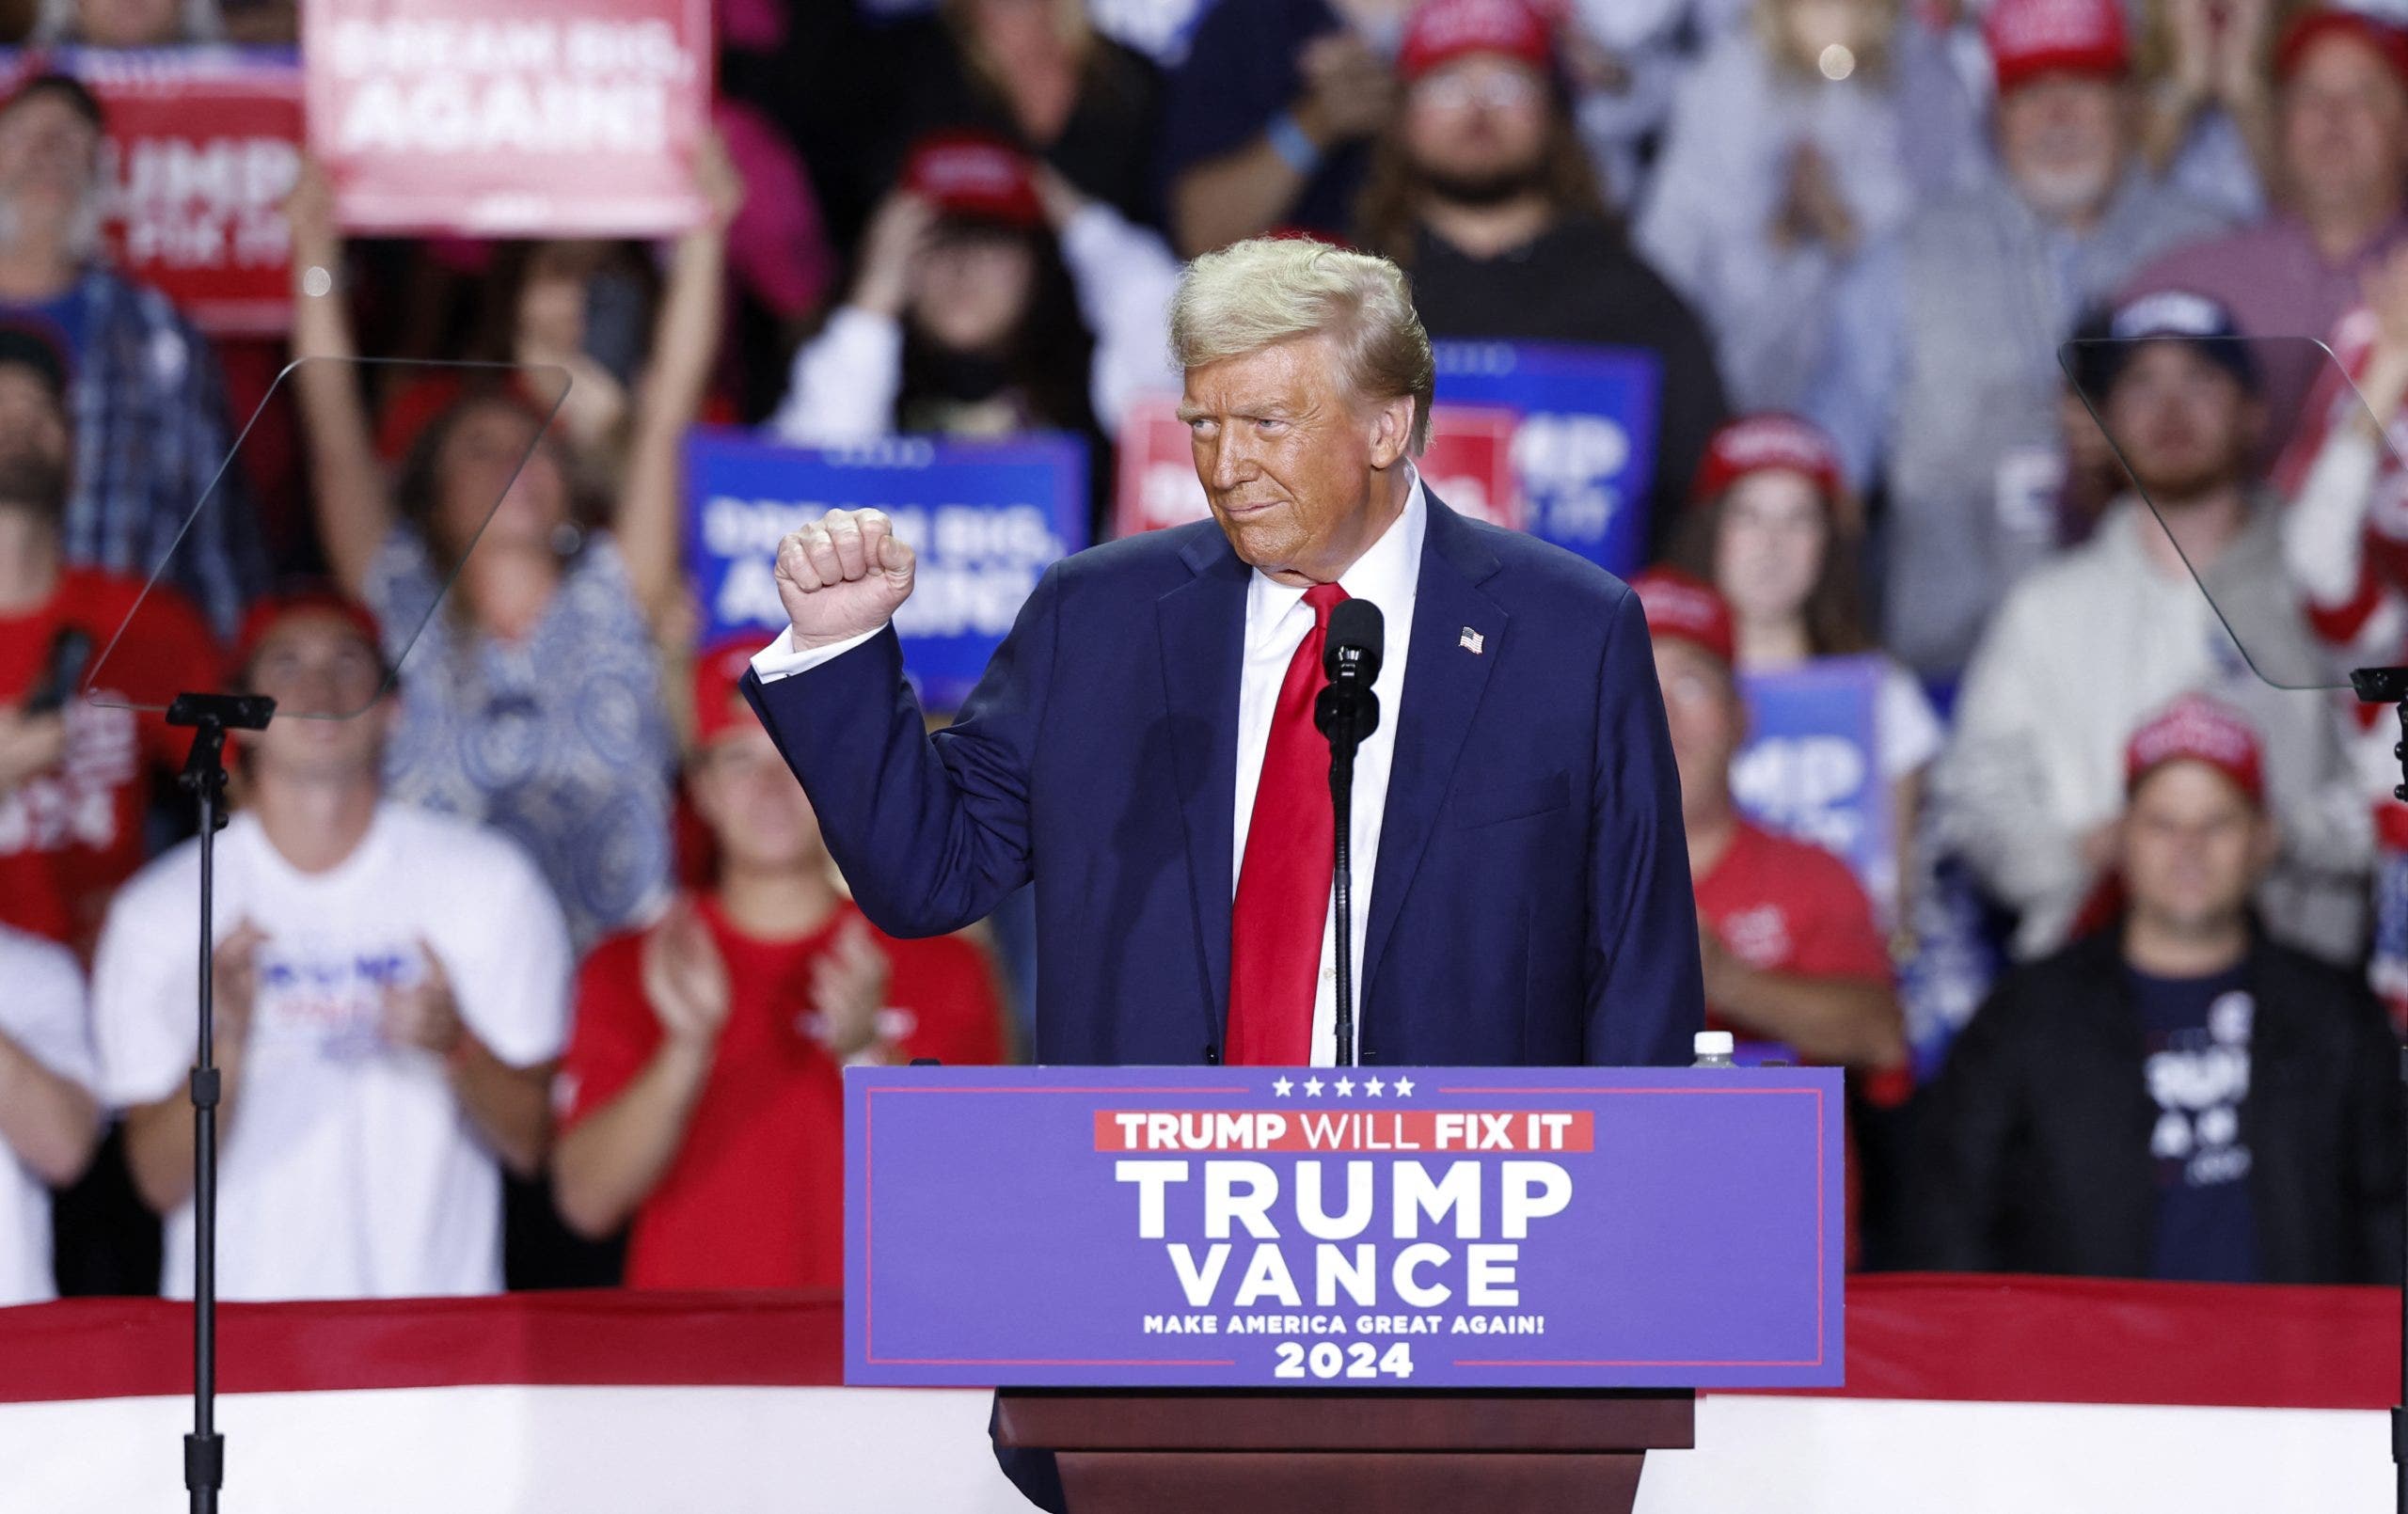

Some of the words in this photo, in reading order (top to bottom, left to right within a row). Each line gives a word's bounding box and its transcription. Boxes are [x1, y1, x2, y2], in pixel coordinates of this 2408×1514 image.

[97, 139, 299, 214] UMP
[1115, 1112, 1287, 1150] TRUMP
[1299, 1113, 1420, 1150] WILL
[1434, 1112, 1514, 1150] FIX
[1527, 1113, 1574, 1150] IT
[1115, 1159, 1574, 1240] TRUMP
[1166, 1243, 1519, 1308] VANCE
[1143, 1315, 1218, 1334] MAKE
[1226, 1315, 1348, 1334] AMERICA
[1355, 1315, 1443, 1334] GREAT
[1450, 1315, 1545, 1334] AGAIN!
[1274, 1341, 1414, 1379] 2024
